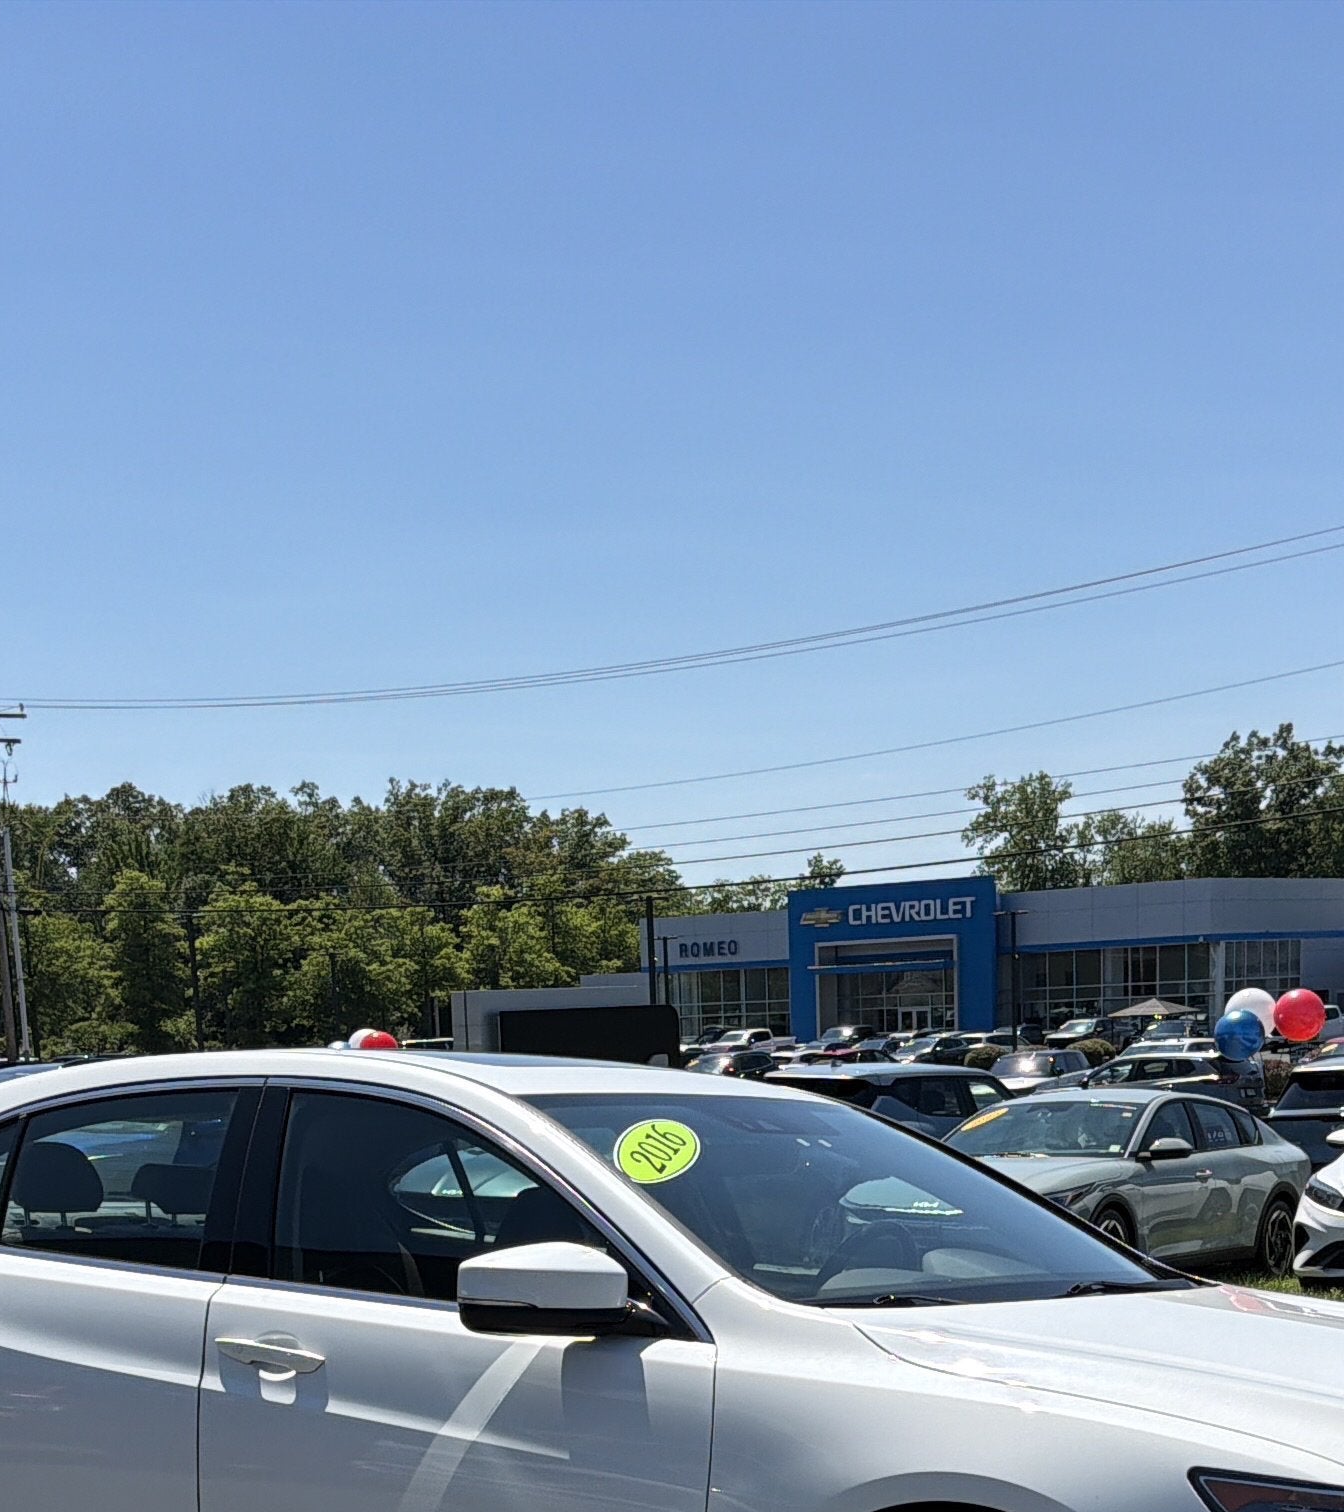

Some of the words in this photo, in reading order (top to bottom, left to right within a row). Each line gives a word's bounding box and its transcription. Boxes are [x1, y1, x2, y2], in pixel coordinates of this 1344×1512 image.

[848, 896, 976, 926] CHEVROLET
[679, 939, 738, 959] ROMEO
[630, 1124, 687, 1174] 2016
